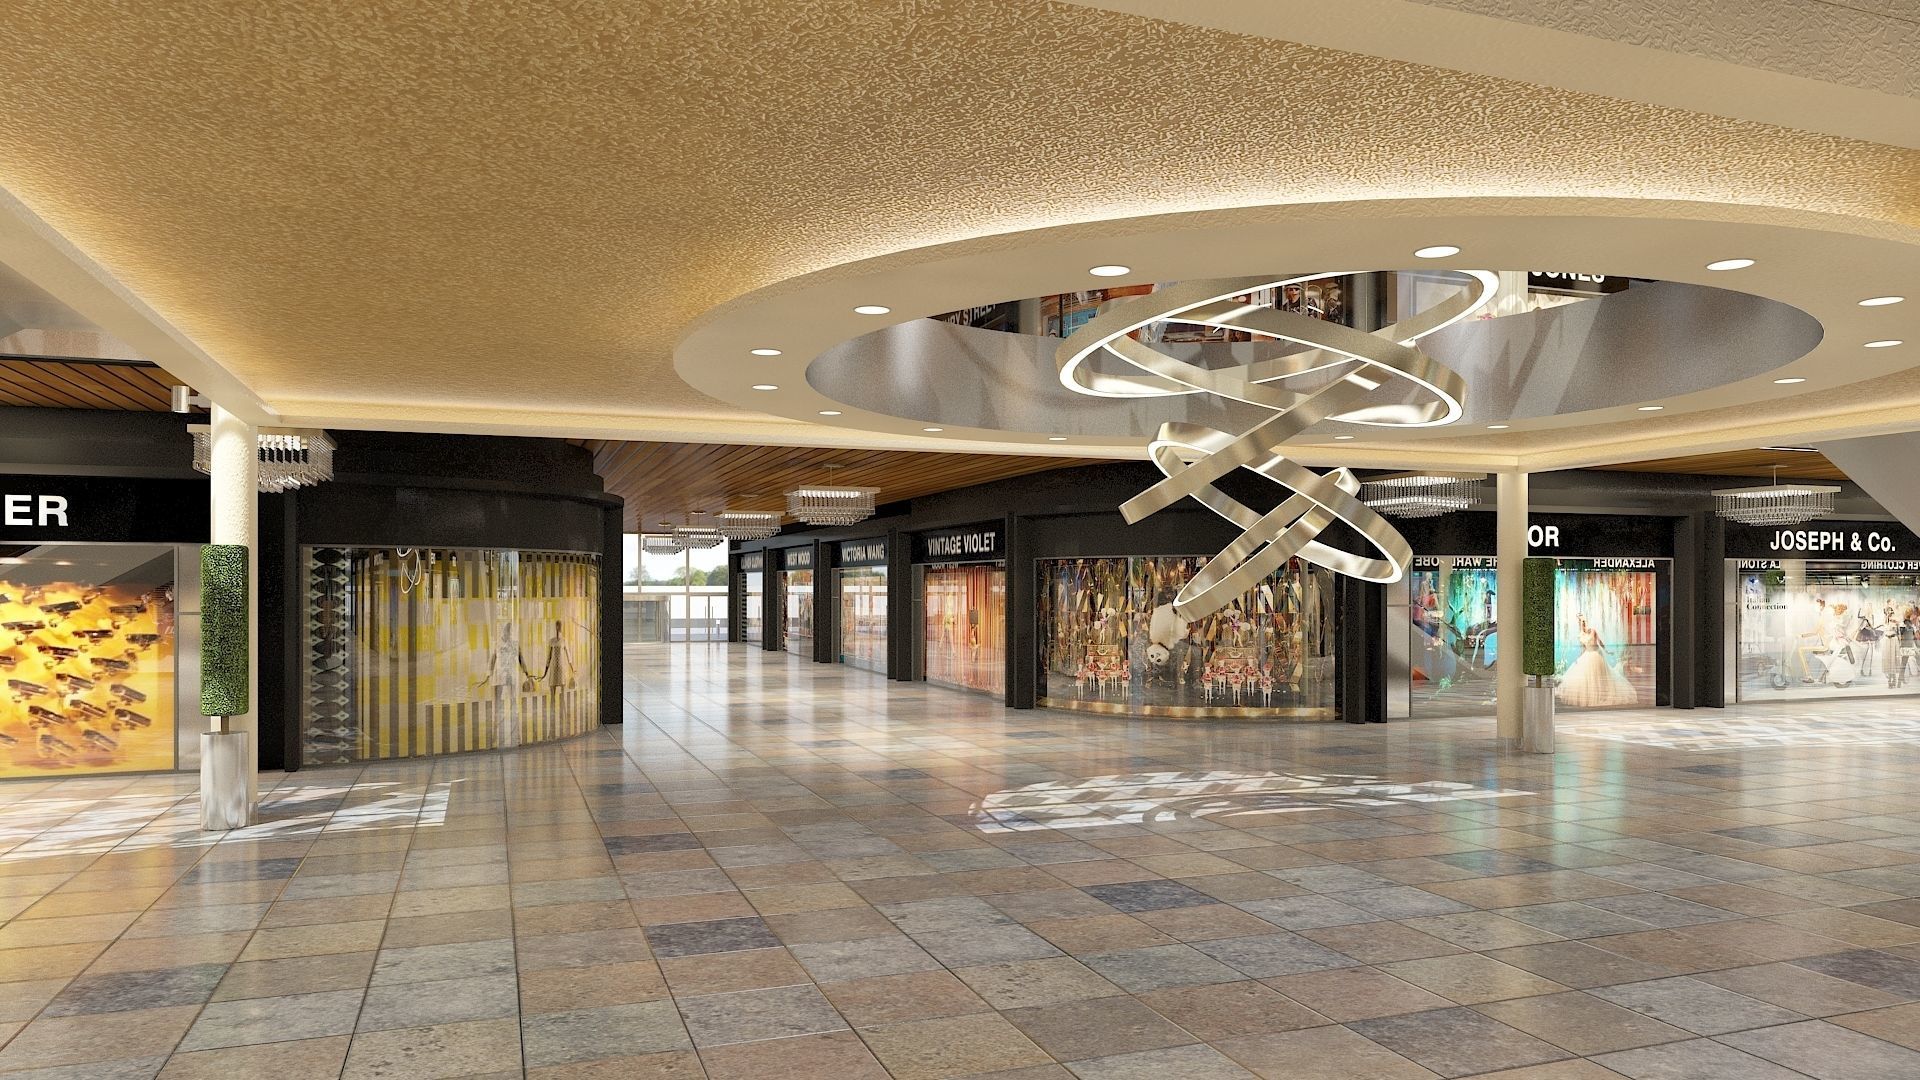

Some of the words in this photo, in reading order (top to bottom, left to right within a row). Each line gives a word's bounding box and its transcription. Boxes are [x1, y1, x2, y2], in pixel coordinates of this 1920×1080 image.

[5, 494, 68, 527] ER
[928, 535, 961, 556] VINTAGE
[963, 532, 995, 554] VIOLET
[1528, 525, 1559, 547] OR
[1770, 530, 1844, 551] JOSEPH
[1850, 532, 1862, 551] &
[1868, 532, 1896, 552] Co.
[841, 546, 866, 563] VICTORIA
